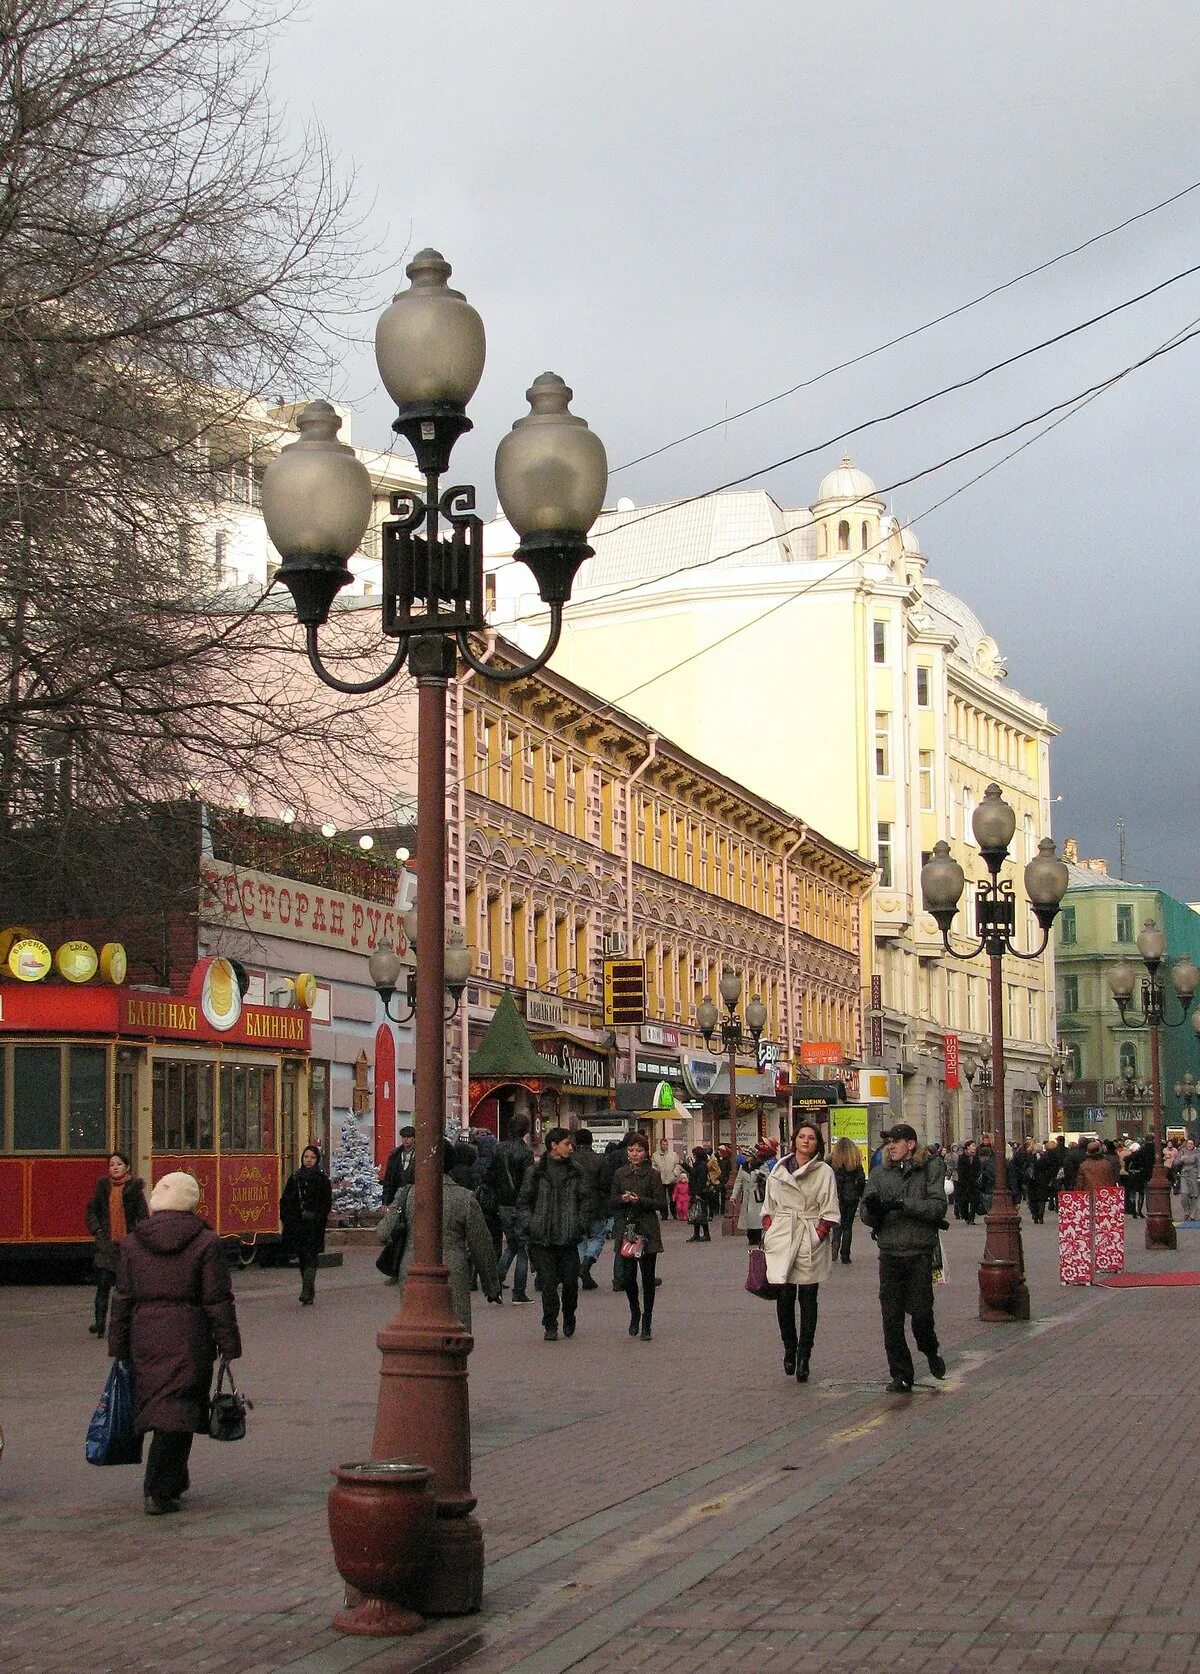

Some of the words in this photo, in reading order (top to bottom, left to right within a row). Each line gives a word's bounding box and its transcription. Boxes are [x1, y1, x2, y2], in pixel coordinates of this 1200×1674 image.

[351, 902, 407, 958] РУСЬ
[127, 999, 198, 1031] БЛИННАЯ
[245, 1012, 305, 1042] БЛИННАЯ
[946, 1038, 957, 1076] ESPRIT
[799, 1098, 827, 1106] ОЦЕНКА
